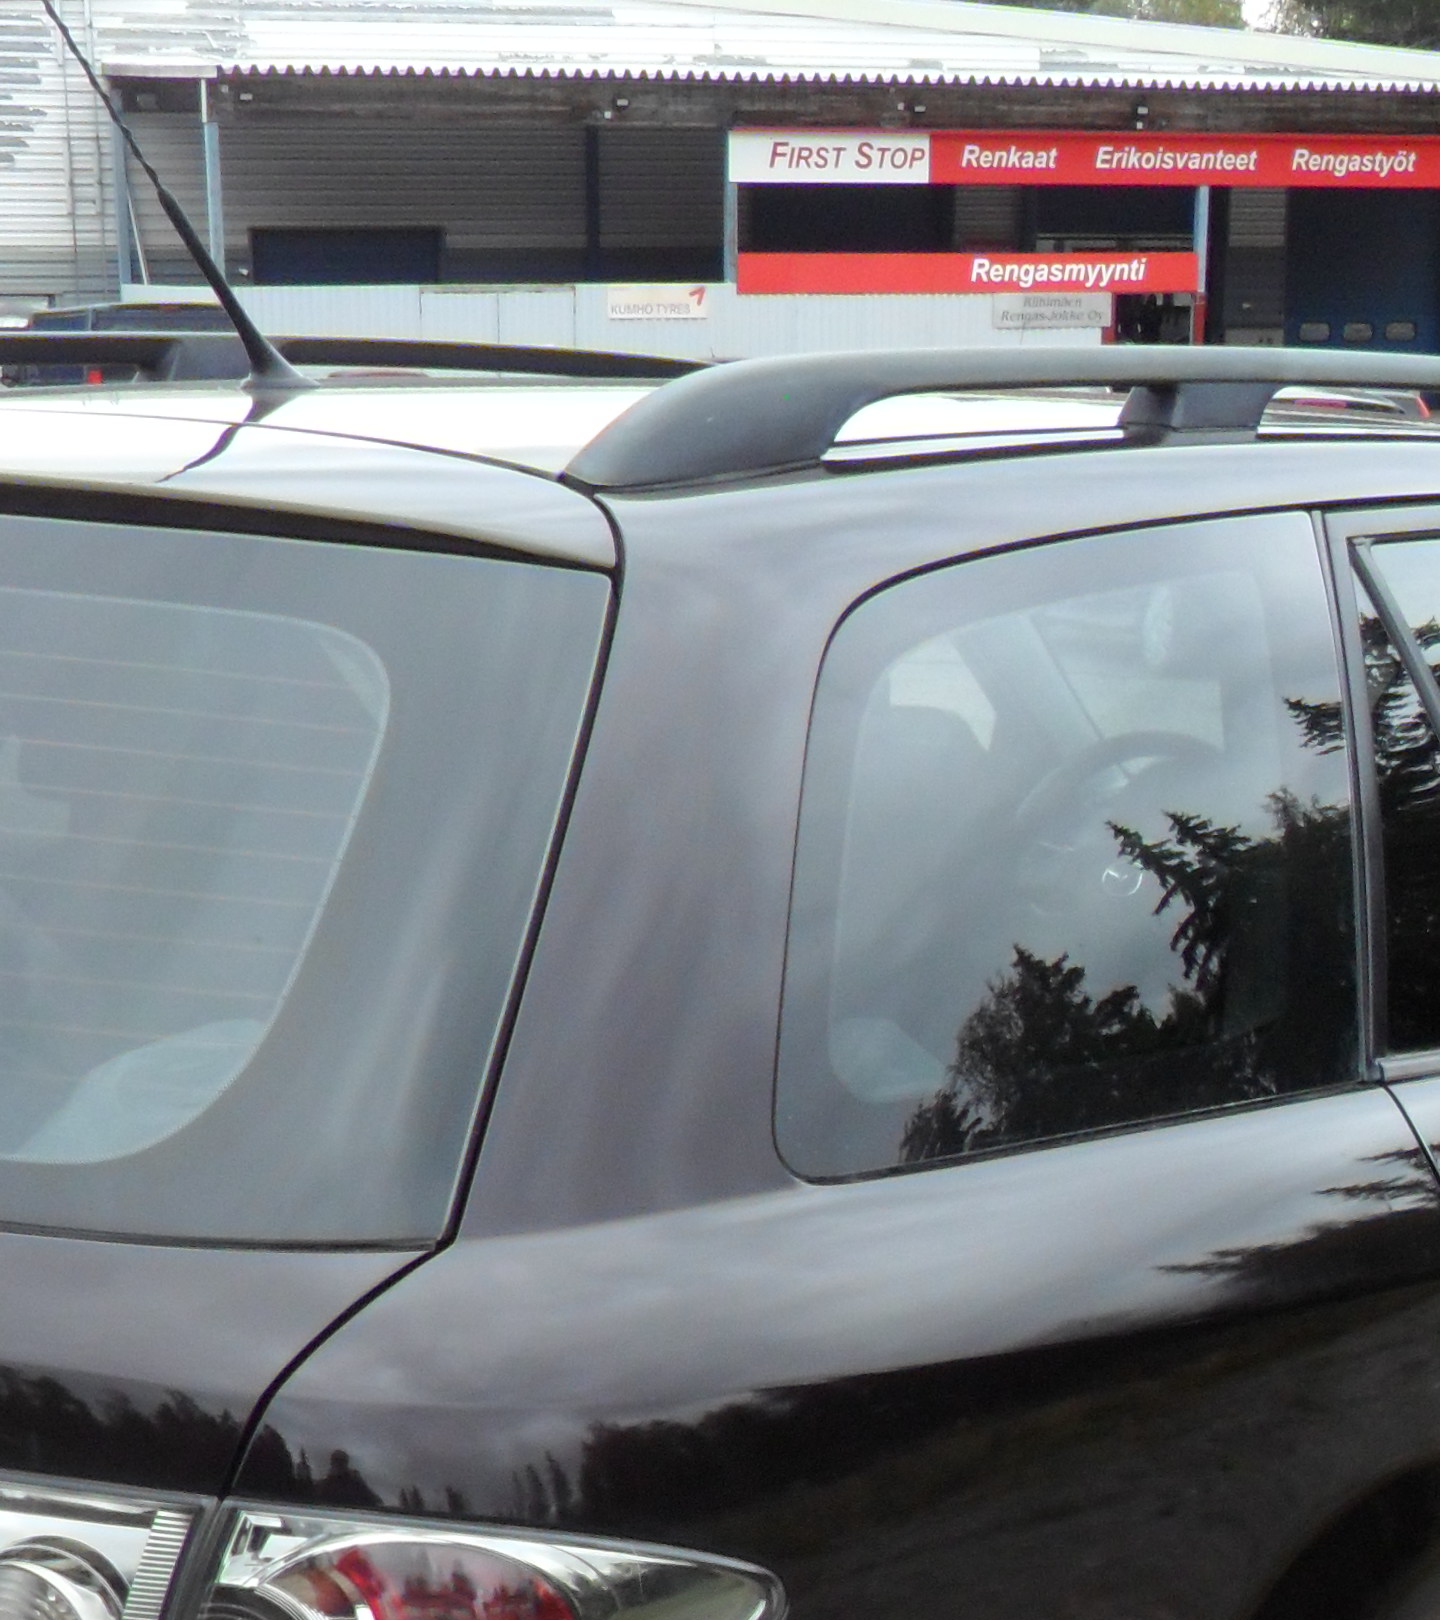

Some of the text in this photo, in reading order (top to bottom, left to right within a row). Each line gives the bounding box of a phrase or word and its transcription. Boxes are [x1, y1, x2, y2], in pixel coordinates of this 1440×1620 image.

[769, 141, 925, 169] FIRST STOP
[961, 144, 1058, 169] Renkaat
[1095, 146, 1258, 170] Erikoisvanteet
[1291, 148, 1417, 177] Rengastyöt
[970, 257, 1148, 287] Rengasmyynti
[611, 303, 653, 315] KUMHO
